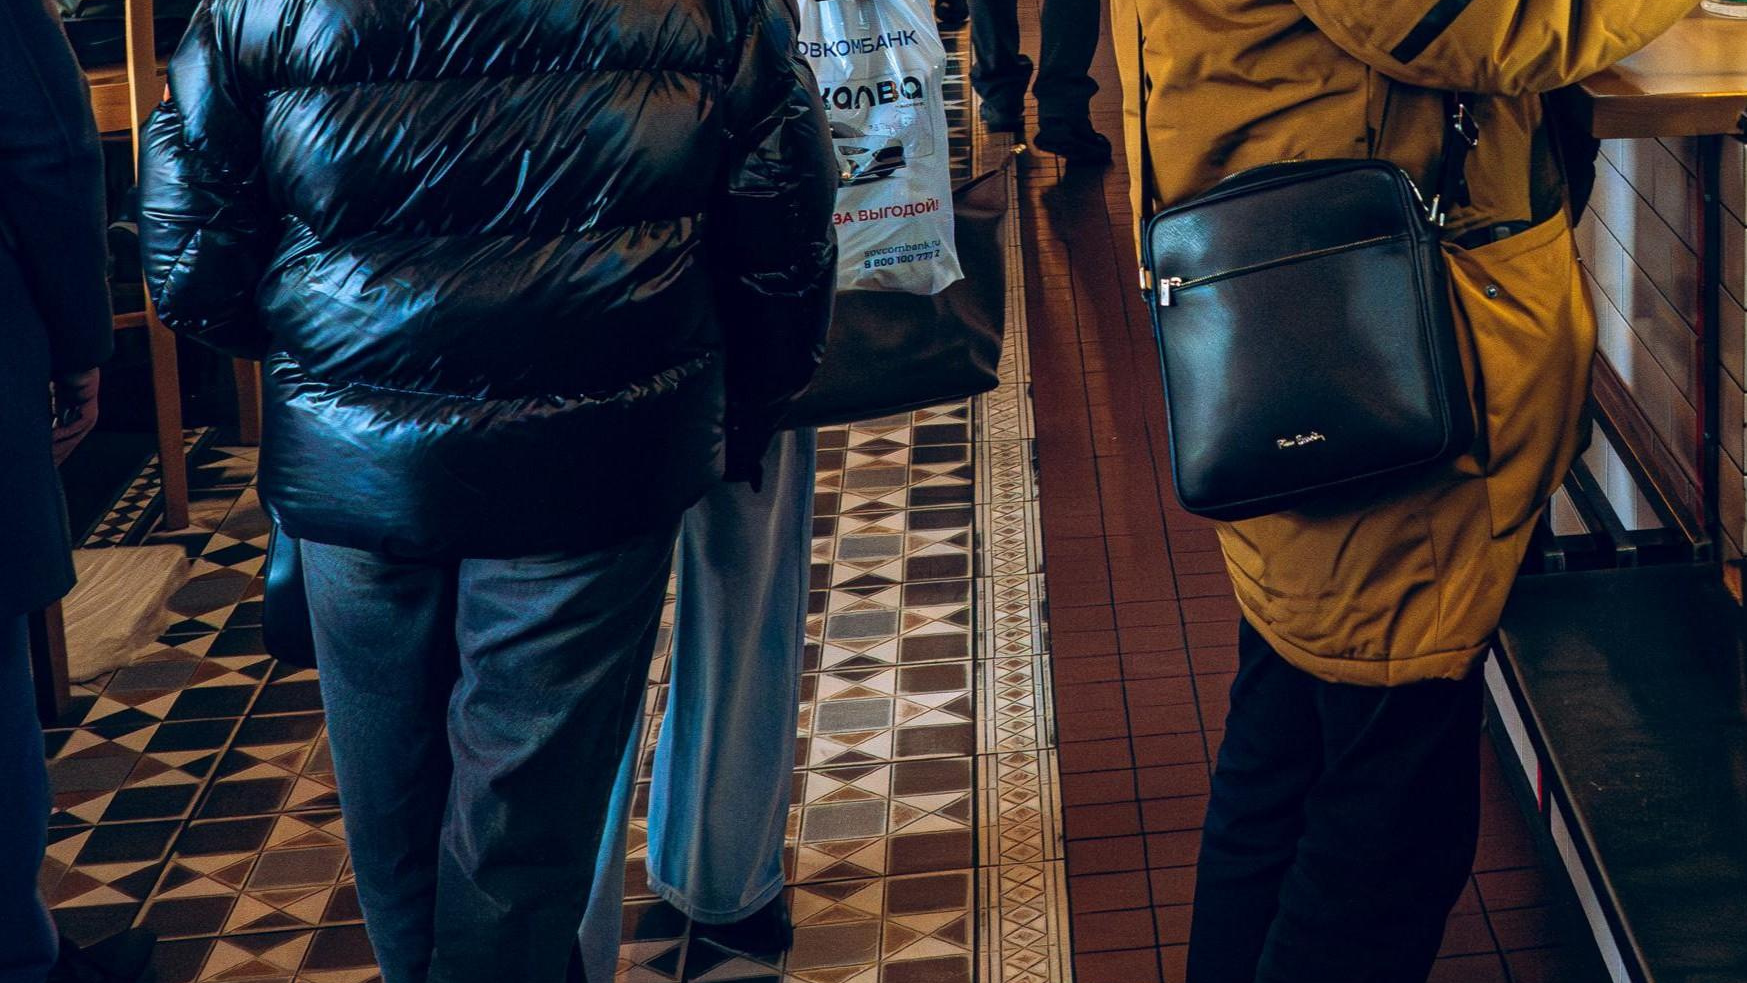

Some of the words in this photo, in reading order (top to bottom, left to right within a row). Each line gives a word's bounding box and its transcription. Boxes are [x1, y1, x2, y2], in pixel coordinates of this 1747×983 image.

[798, 30, 919, 58] ОВКОМБАНК
[833, 212, 854, 225] ЗА
[858, 198, 940, 222] ВЫГОДОЙ!
[864, 239, 941, 258] sovcombank.ru
[864, 260, 871, 269] 8
[874, 257, 894, 267] 800
[897, 254, 914, 264] 100
